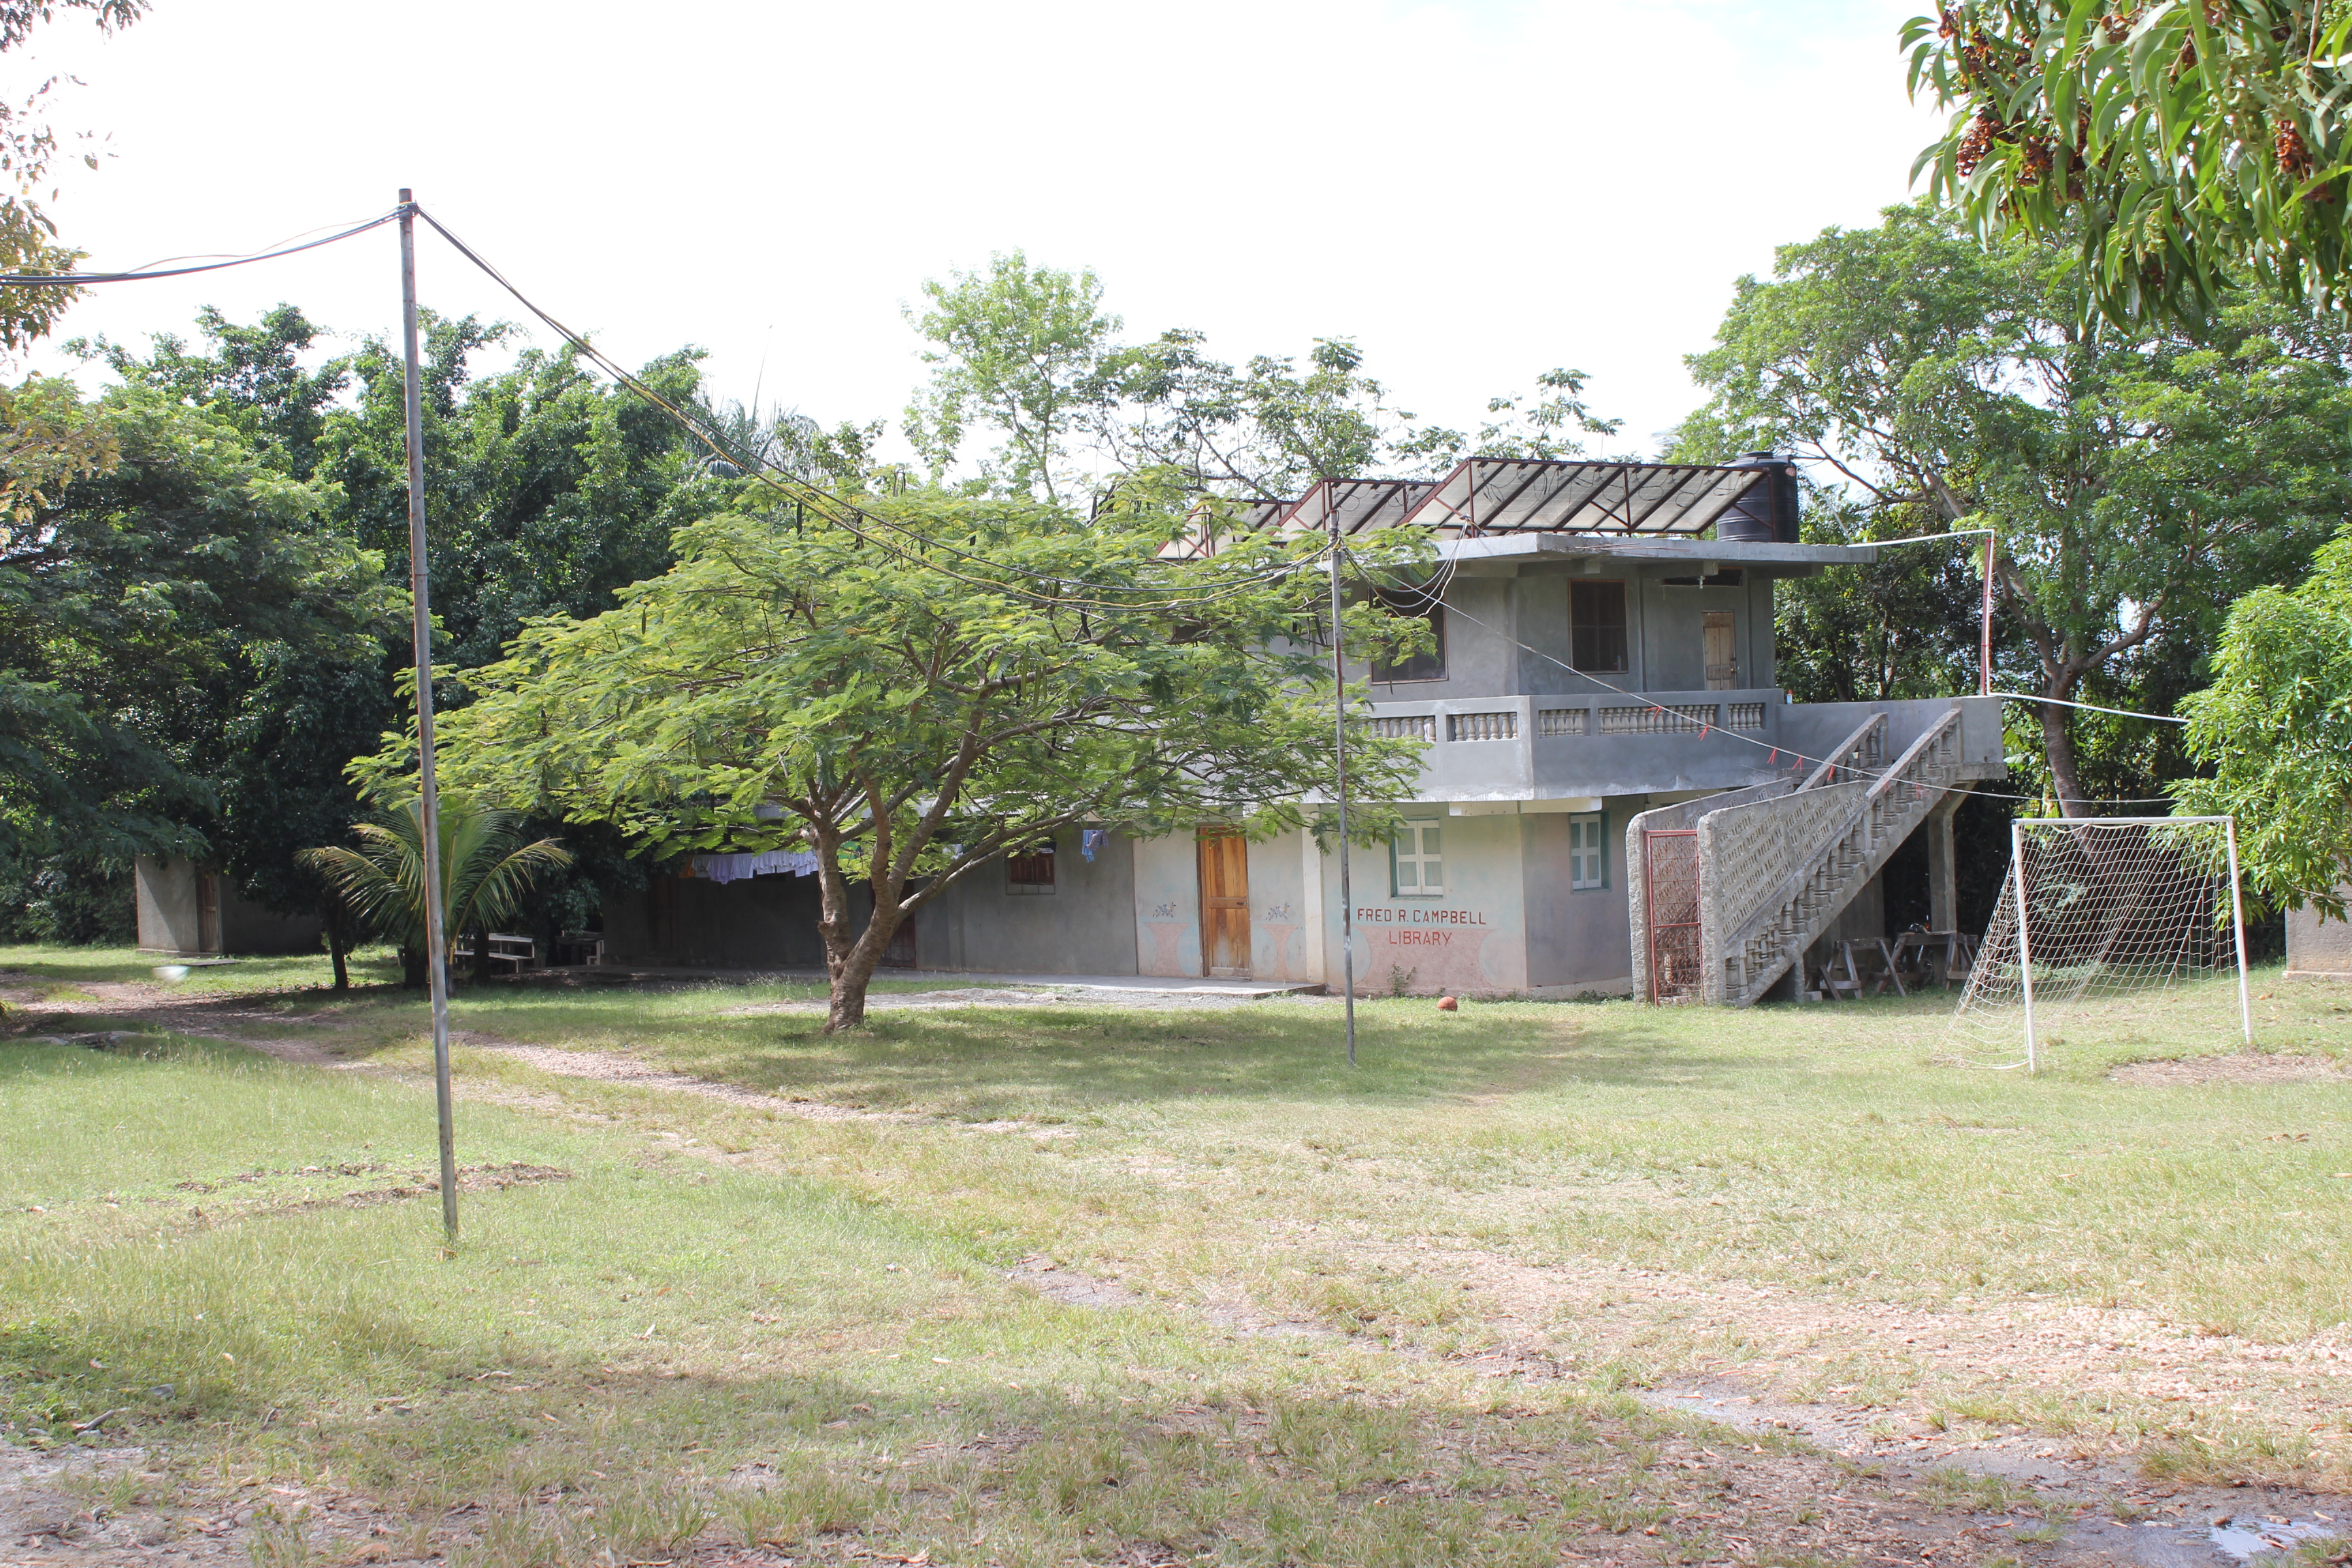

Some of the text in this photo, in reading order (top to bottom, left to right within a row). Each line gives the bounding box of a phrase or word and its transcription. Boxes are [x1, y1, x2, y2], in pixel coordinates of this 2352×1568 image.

[1358, 909, 1486, 925] FRED R. CAMPBELL
[1389, 930, 1452, 946] LIBRARY
